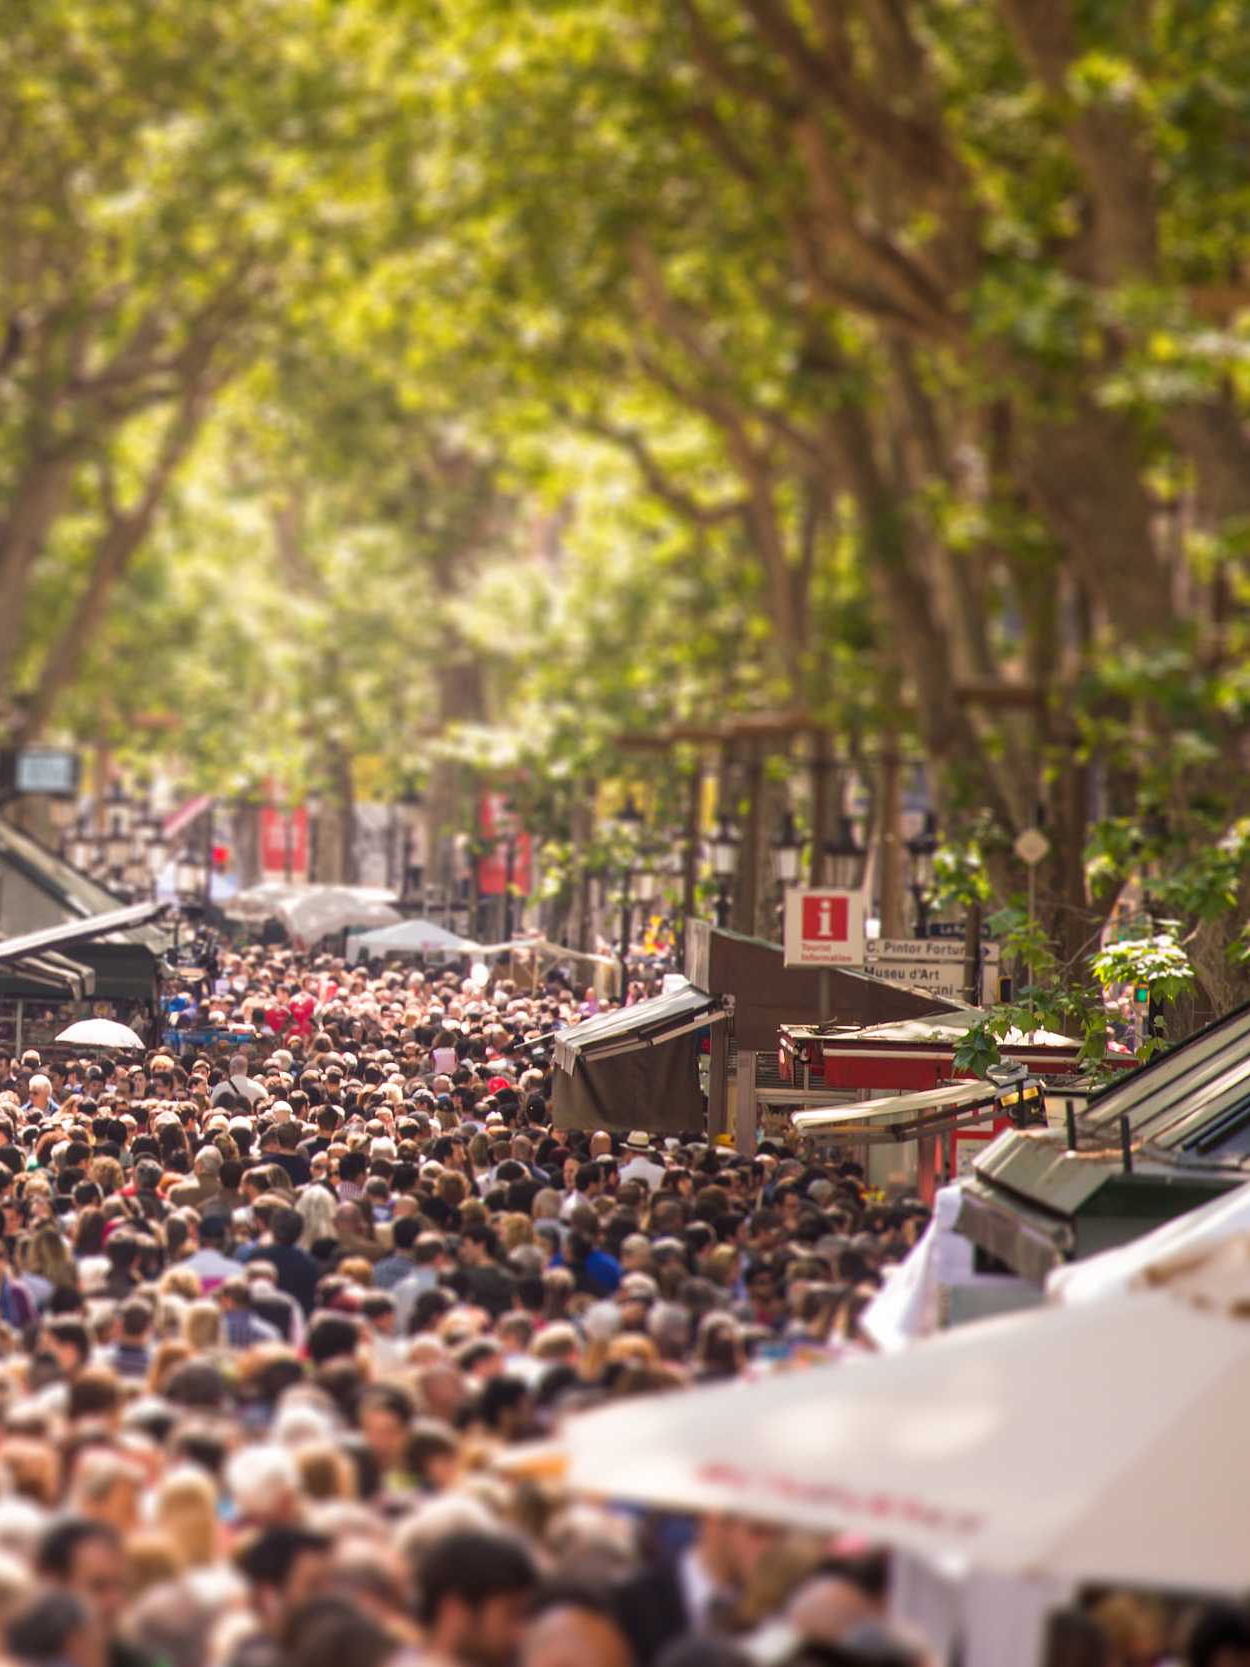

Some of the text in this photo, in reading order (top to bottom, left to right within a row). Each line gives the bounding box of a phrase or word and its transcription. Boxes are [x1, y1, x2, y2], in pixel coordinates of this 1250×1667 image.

[866, 942, 880, 953] C.
[884, 942, 922, 954] Pintor
[864, 965, 940, 980] Museu d'Art
